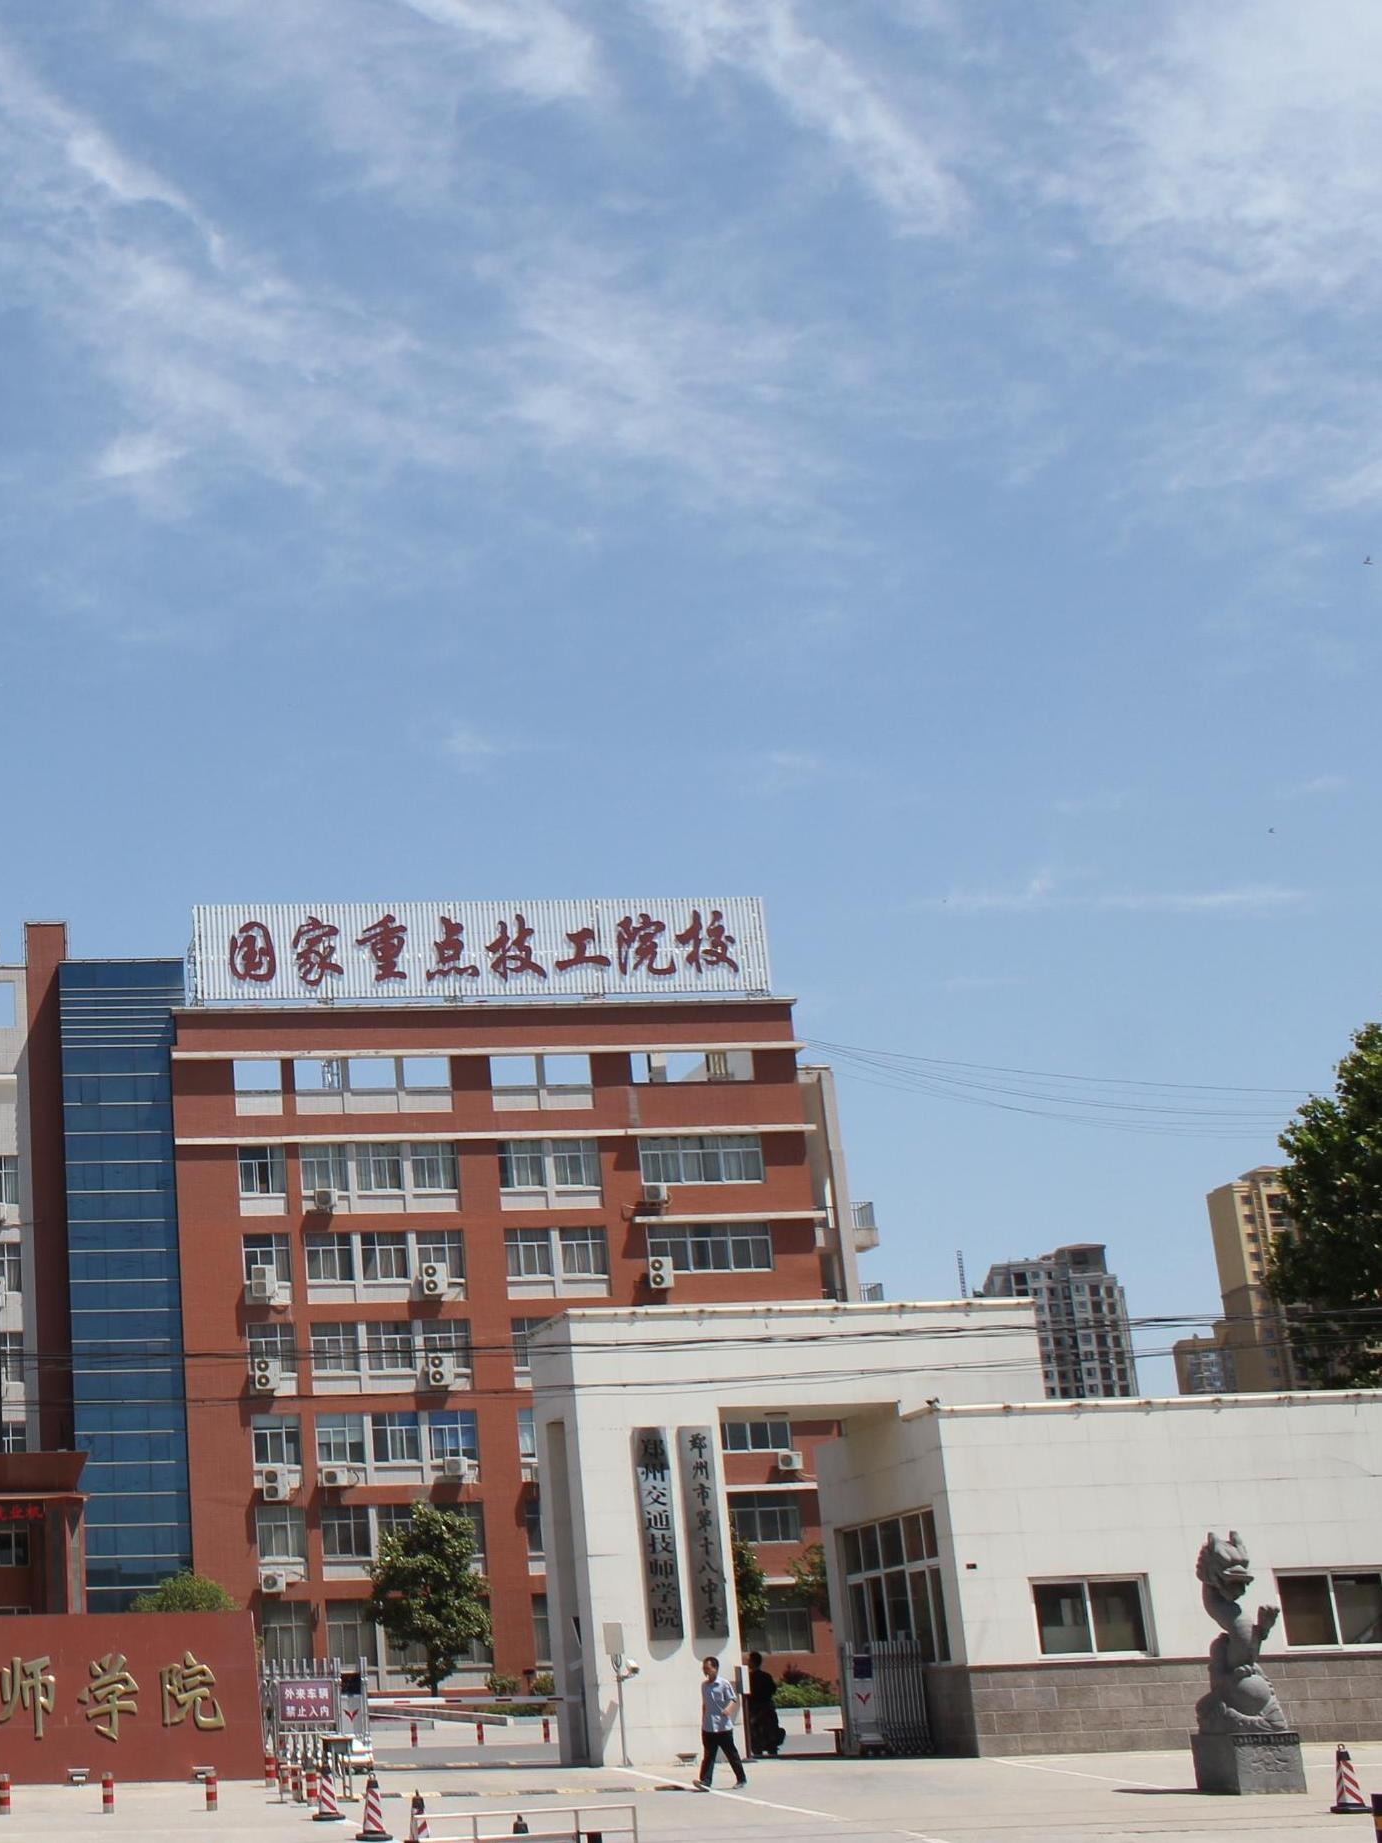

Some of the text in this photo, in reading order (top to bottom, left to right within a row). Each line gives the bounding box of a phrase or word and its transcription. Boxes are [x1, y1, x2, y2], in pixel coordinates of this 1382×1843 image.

[229, 909, 740, 986] 国家重点技工院校
[640, 1438, 680, 1628] 郑州交通技师学院
[284, 1687, 329, 1700] 外来车辆
[285, 1705, 330, 1718] 禁止入内
